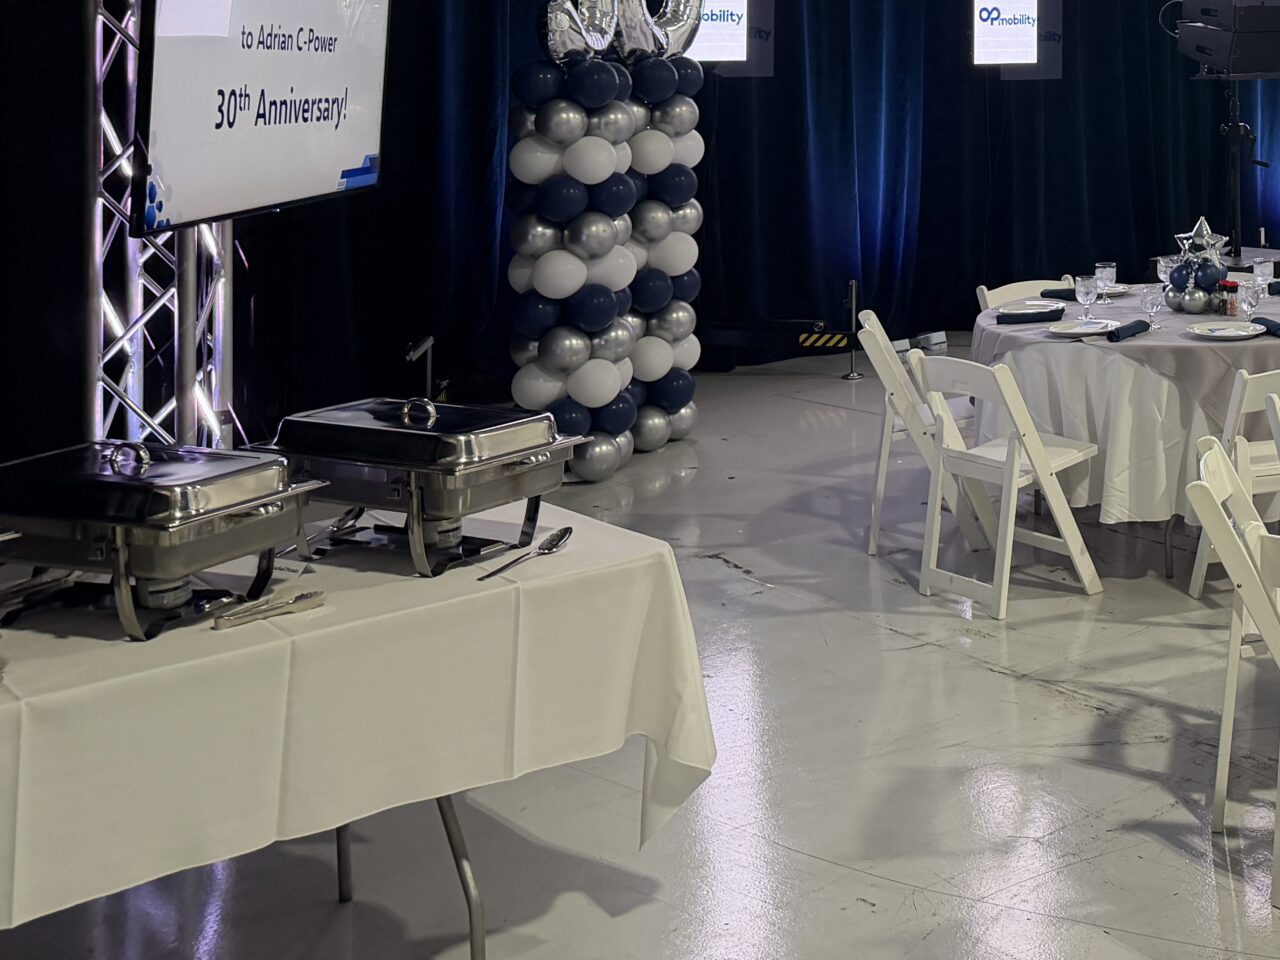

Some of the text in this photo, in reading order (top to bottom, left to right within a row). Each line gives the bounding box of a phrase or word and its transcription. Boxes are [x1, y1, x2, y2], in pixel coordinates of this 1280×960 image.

[702, 9, 744, 25] obility
[979, 6, 1038, 28] OPmobility
[241, 24, 338, 53] to Adrian C-Power
[214, 84, 348, 131] 30th Anniversary!
